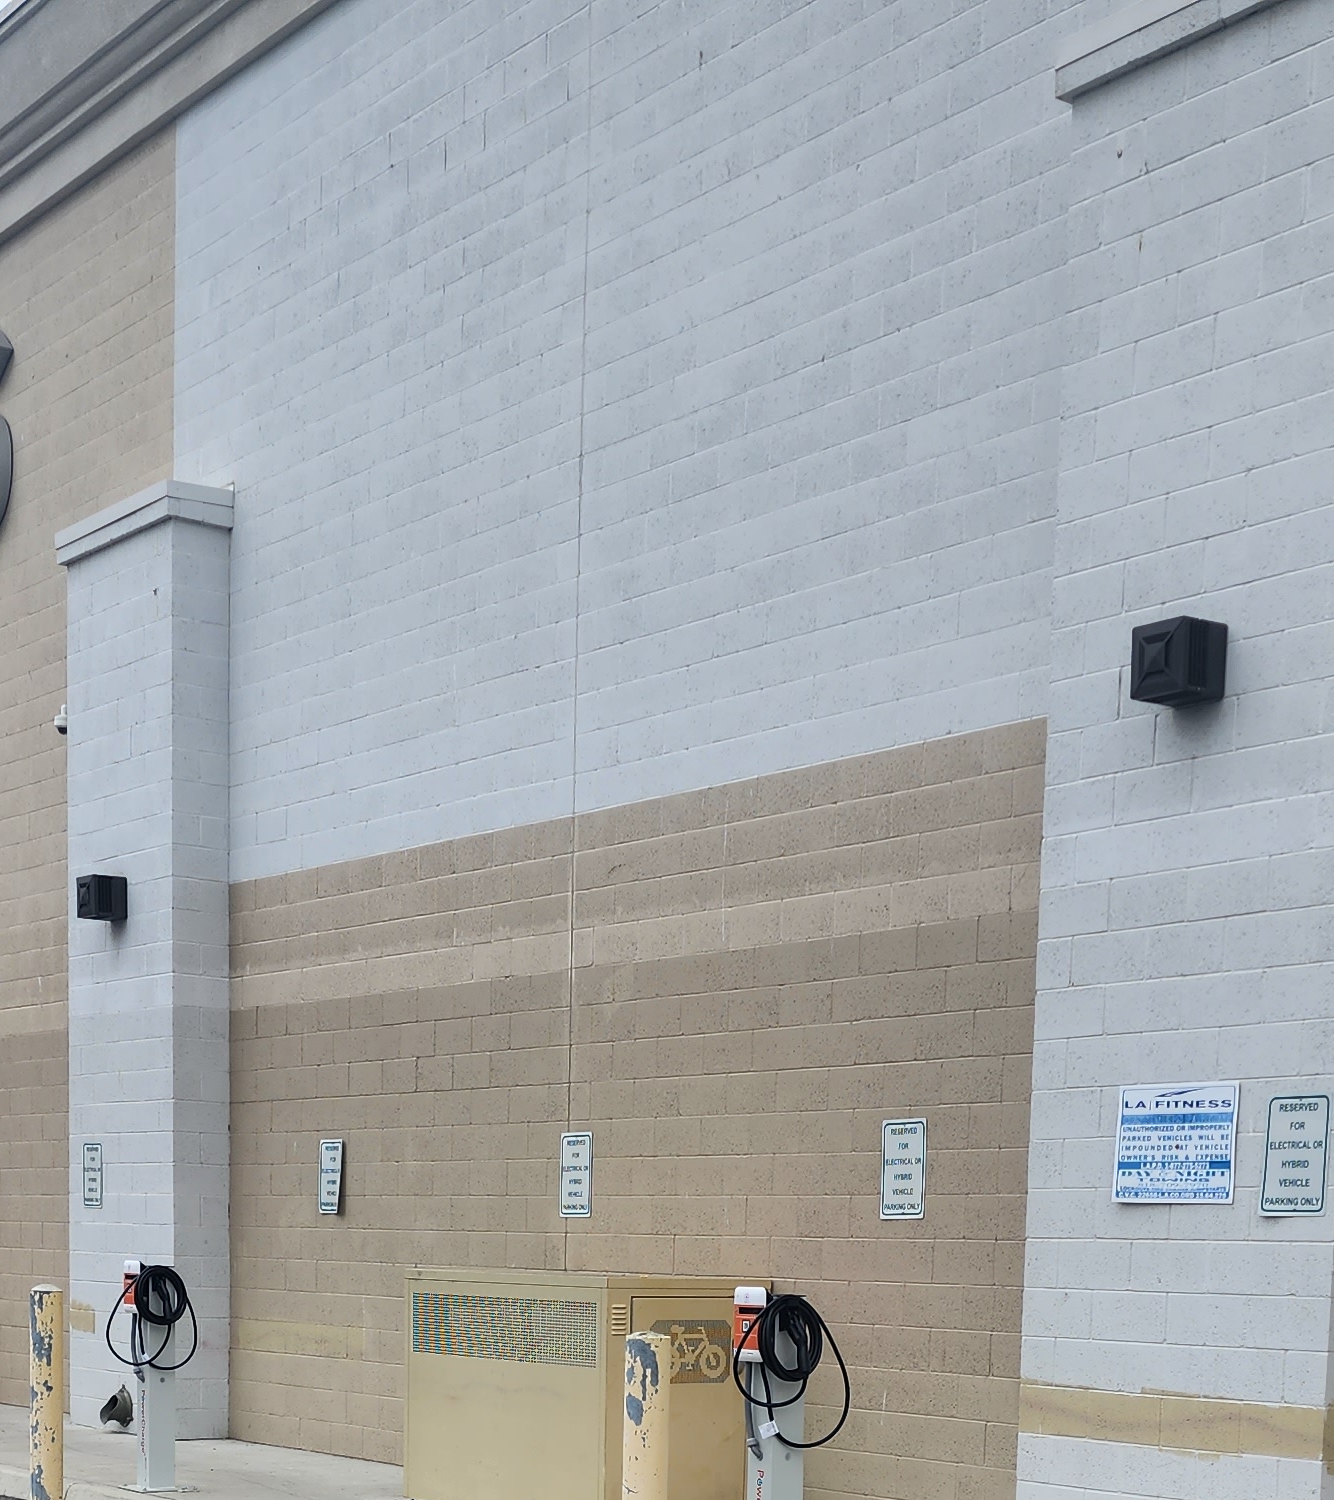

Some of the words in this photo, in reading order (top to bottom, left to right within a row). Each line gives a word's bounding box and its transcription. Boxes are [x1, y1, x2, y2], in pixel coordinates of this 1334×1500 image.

[1124, 1100, 1147, 1109] LA
[1155, 1099, 1232, 1109] FITNESS
[1278, 1102, 1319, 1113] RESERVED
[1122, 1125, 1174, 1133] UNAUTHORIZED
[1187, 1124, 1230, 1132] IMPROPERLY
[1289, 1121, 1306, 1131] FOR
[1157, 1134, 1193, 1142] VEHICLES
[1121, 1144, 1174, 1152] IMPOUNDED
[1194, 1143, 1229, 1151] VEHICLE
[1269, 1141, 1312, 1151] ELECTRICAL
[1312, 1140, 1324, 1149] OR
[1195, 1153, 1229, 1161] EXPENSE
[1280, 1160, 1310, 1169] HYBRID
[1278, 1178, 1311, 1188] VEHICLE
[1264, 1197, 1299, 1206] PARKING
[1300, 1197, 1321, 1206] ONLY
